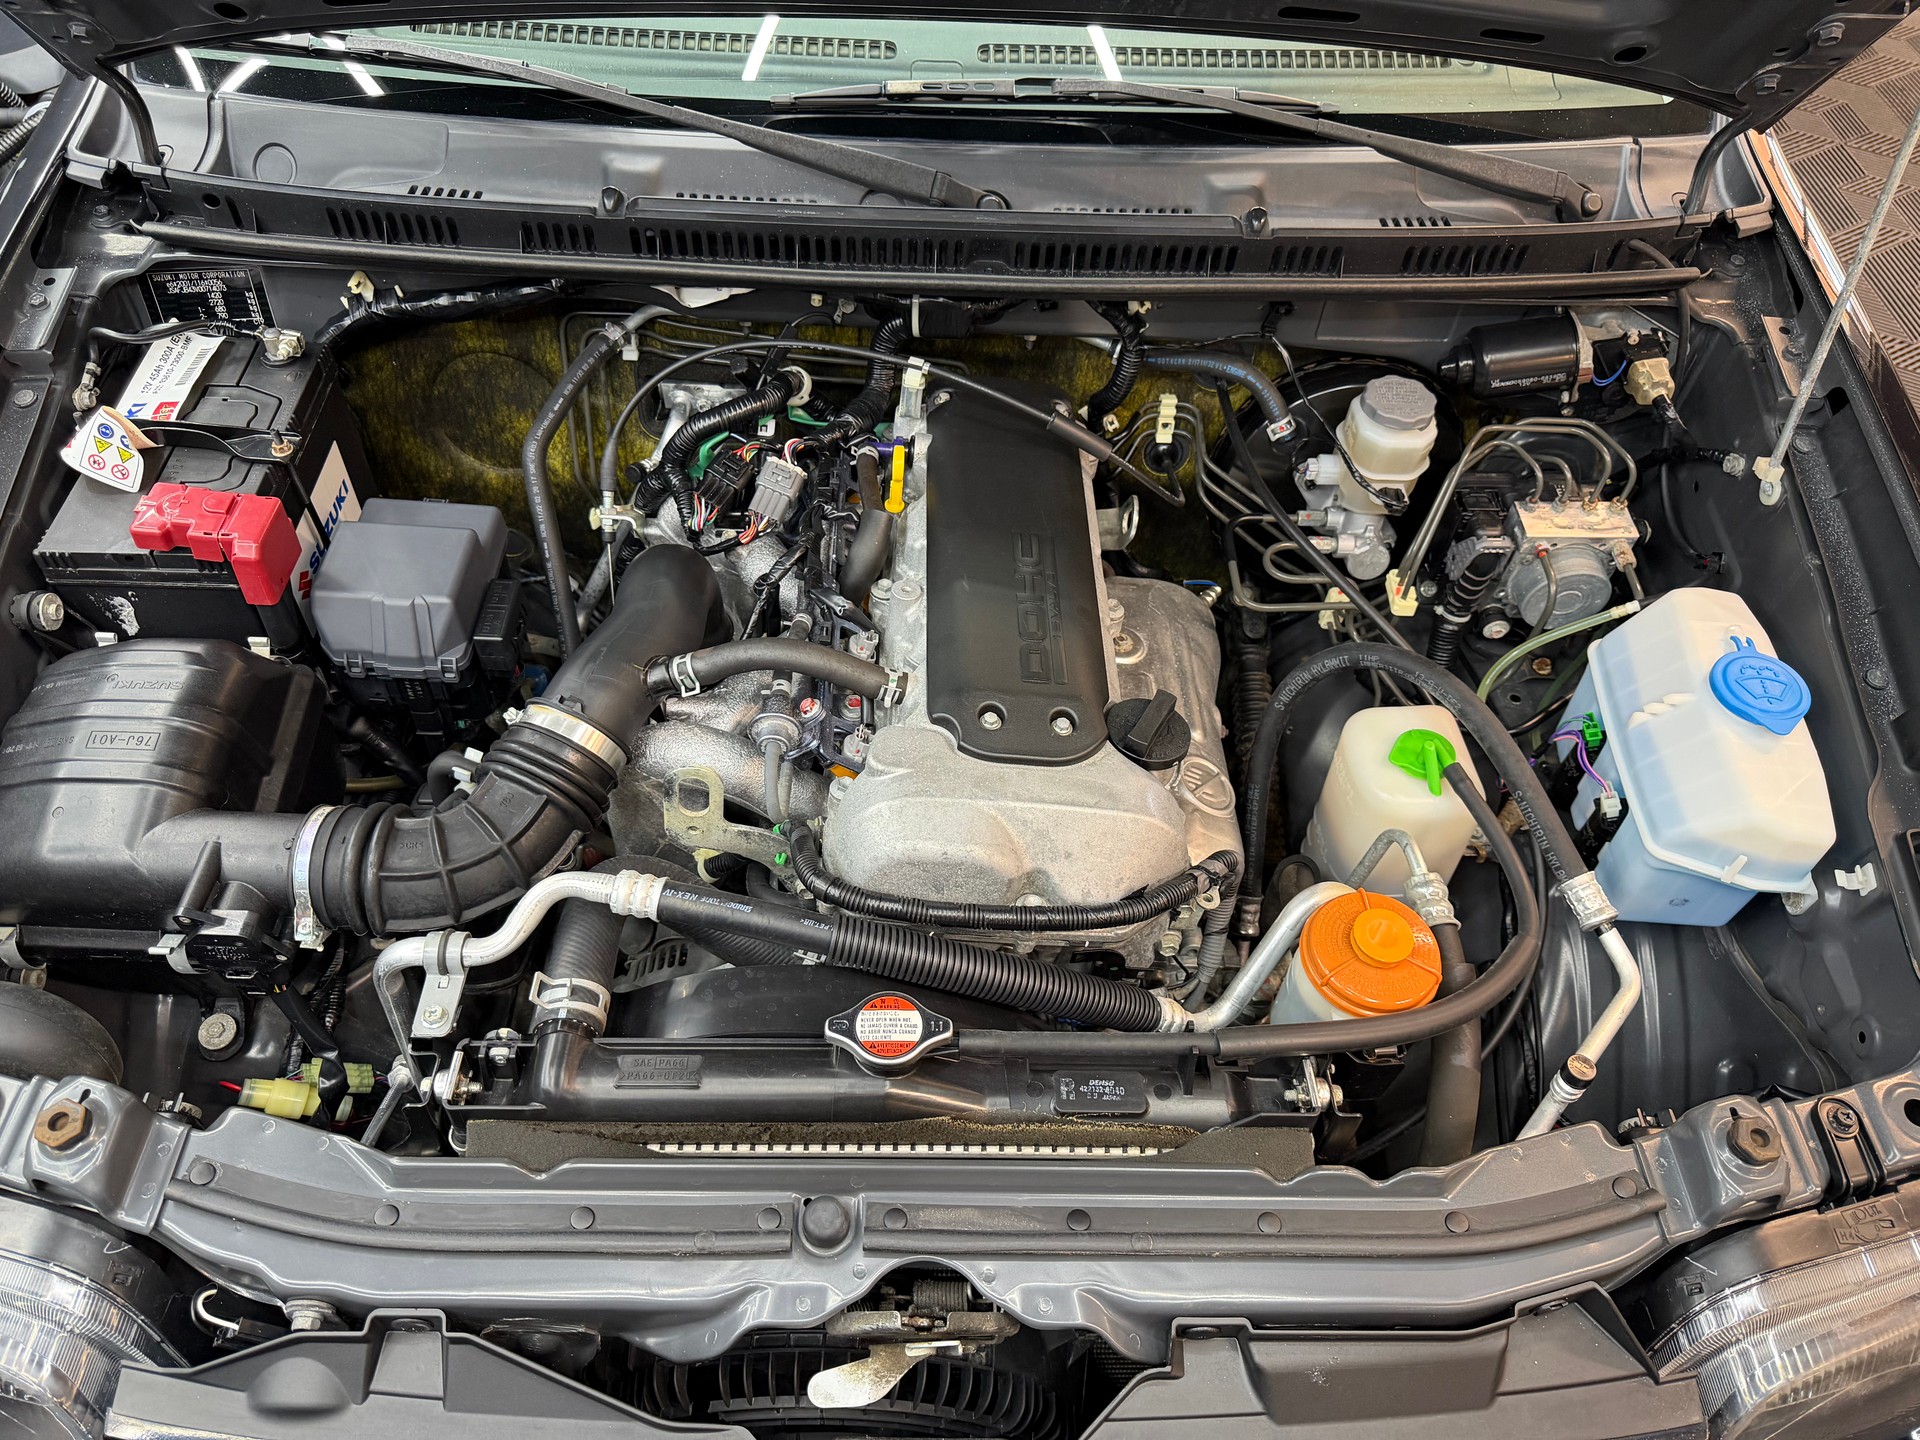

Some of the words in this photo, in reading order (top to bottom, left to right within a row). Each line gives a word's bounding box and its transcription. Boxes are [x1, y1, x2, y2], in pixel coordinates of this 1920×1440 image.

[202, 271, 246, 279] CORPORATION
[148, 362, 165, 382] 45Ah
[159, 344, 175, 365] 300A
[1012, 531, 1051, 684] DOHC
[113, 680, 185, 689] SUZUKI
[91, 734, 153, 746] 76J-A01
[663, 888, 698, 901] NEX-IV
[930, 1021, 943, 1031] 1.1
[634, 1059, 652, 1067] SAE
[658, 1059, 685, 1067] PA66
